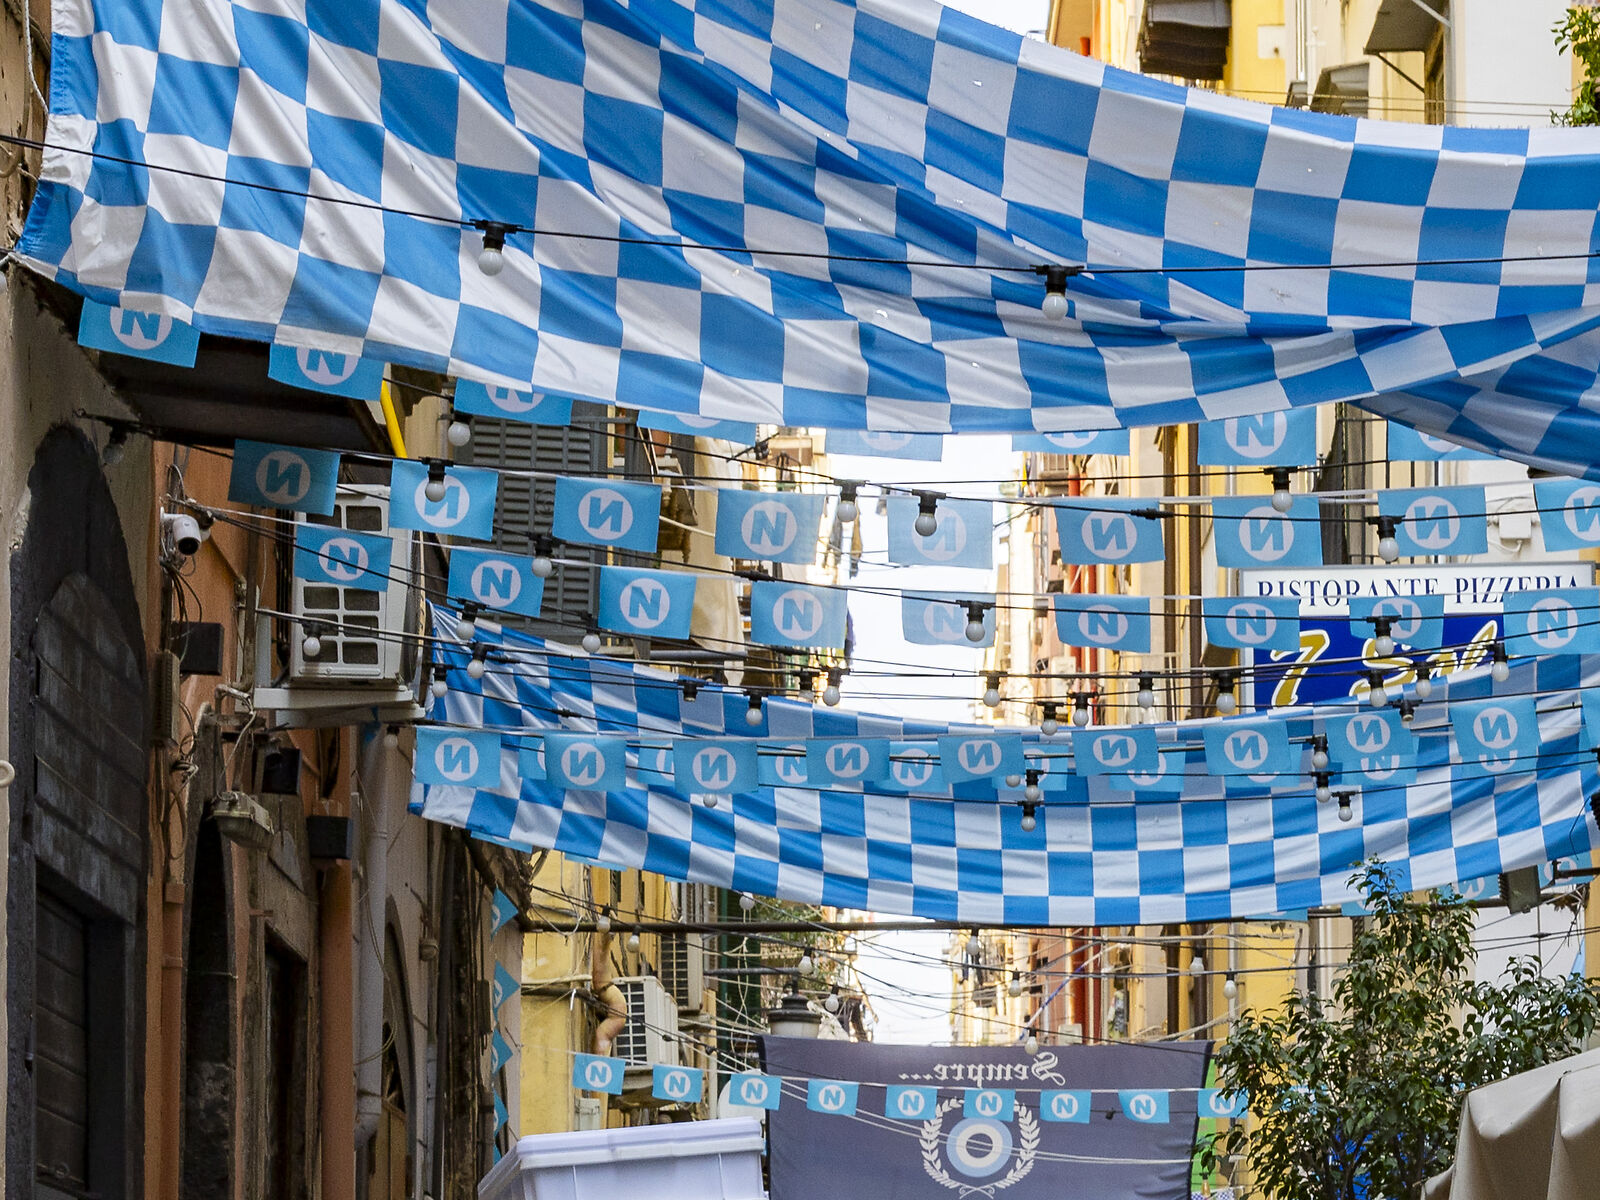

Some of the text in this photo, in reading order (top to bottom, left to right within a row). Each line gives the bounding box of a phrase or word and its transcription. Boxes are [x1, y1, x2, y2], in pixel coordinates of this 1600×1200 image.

[1236, 411, 1275, 446] N
[750, 511, 787, 546] N
[328, 545, 359, 574] N
[481, 567, 512, 599] N
[629, 586, 661, 620] N
[783, 598, 812, 630] N
[933, 605, 961, 636] N
[1088, 610, 1118, 636] N
[1235, 609, 1267, 636] N
[1537, 607, 1568, 638] N
[1270, 629, 1330, 708] 7
[590, 1066, 606, 1082] N
[669, 1076, 685, 1092] N
[746, 1083, 762, 1099] N
[824, 1090, 840, 1105] N
[903, 1095, 919, 1110] N
[981, 1096, 997, 1111] N
[1057, 1099, 1072, 1113] N
[1136, 1101, 1150, 1114] N
